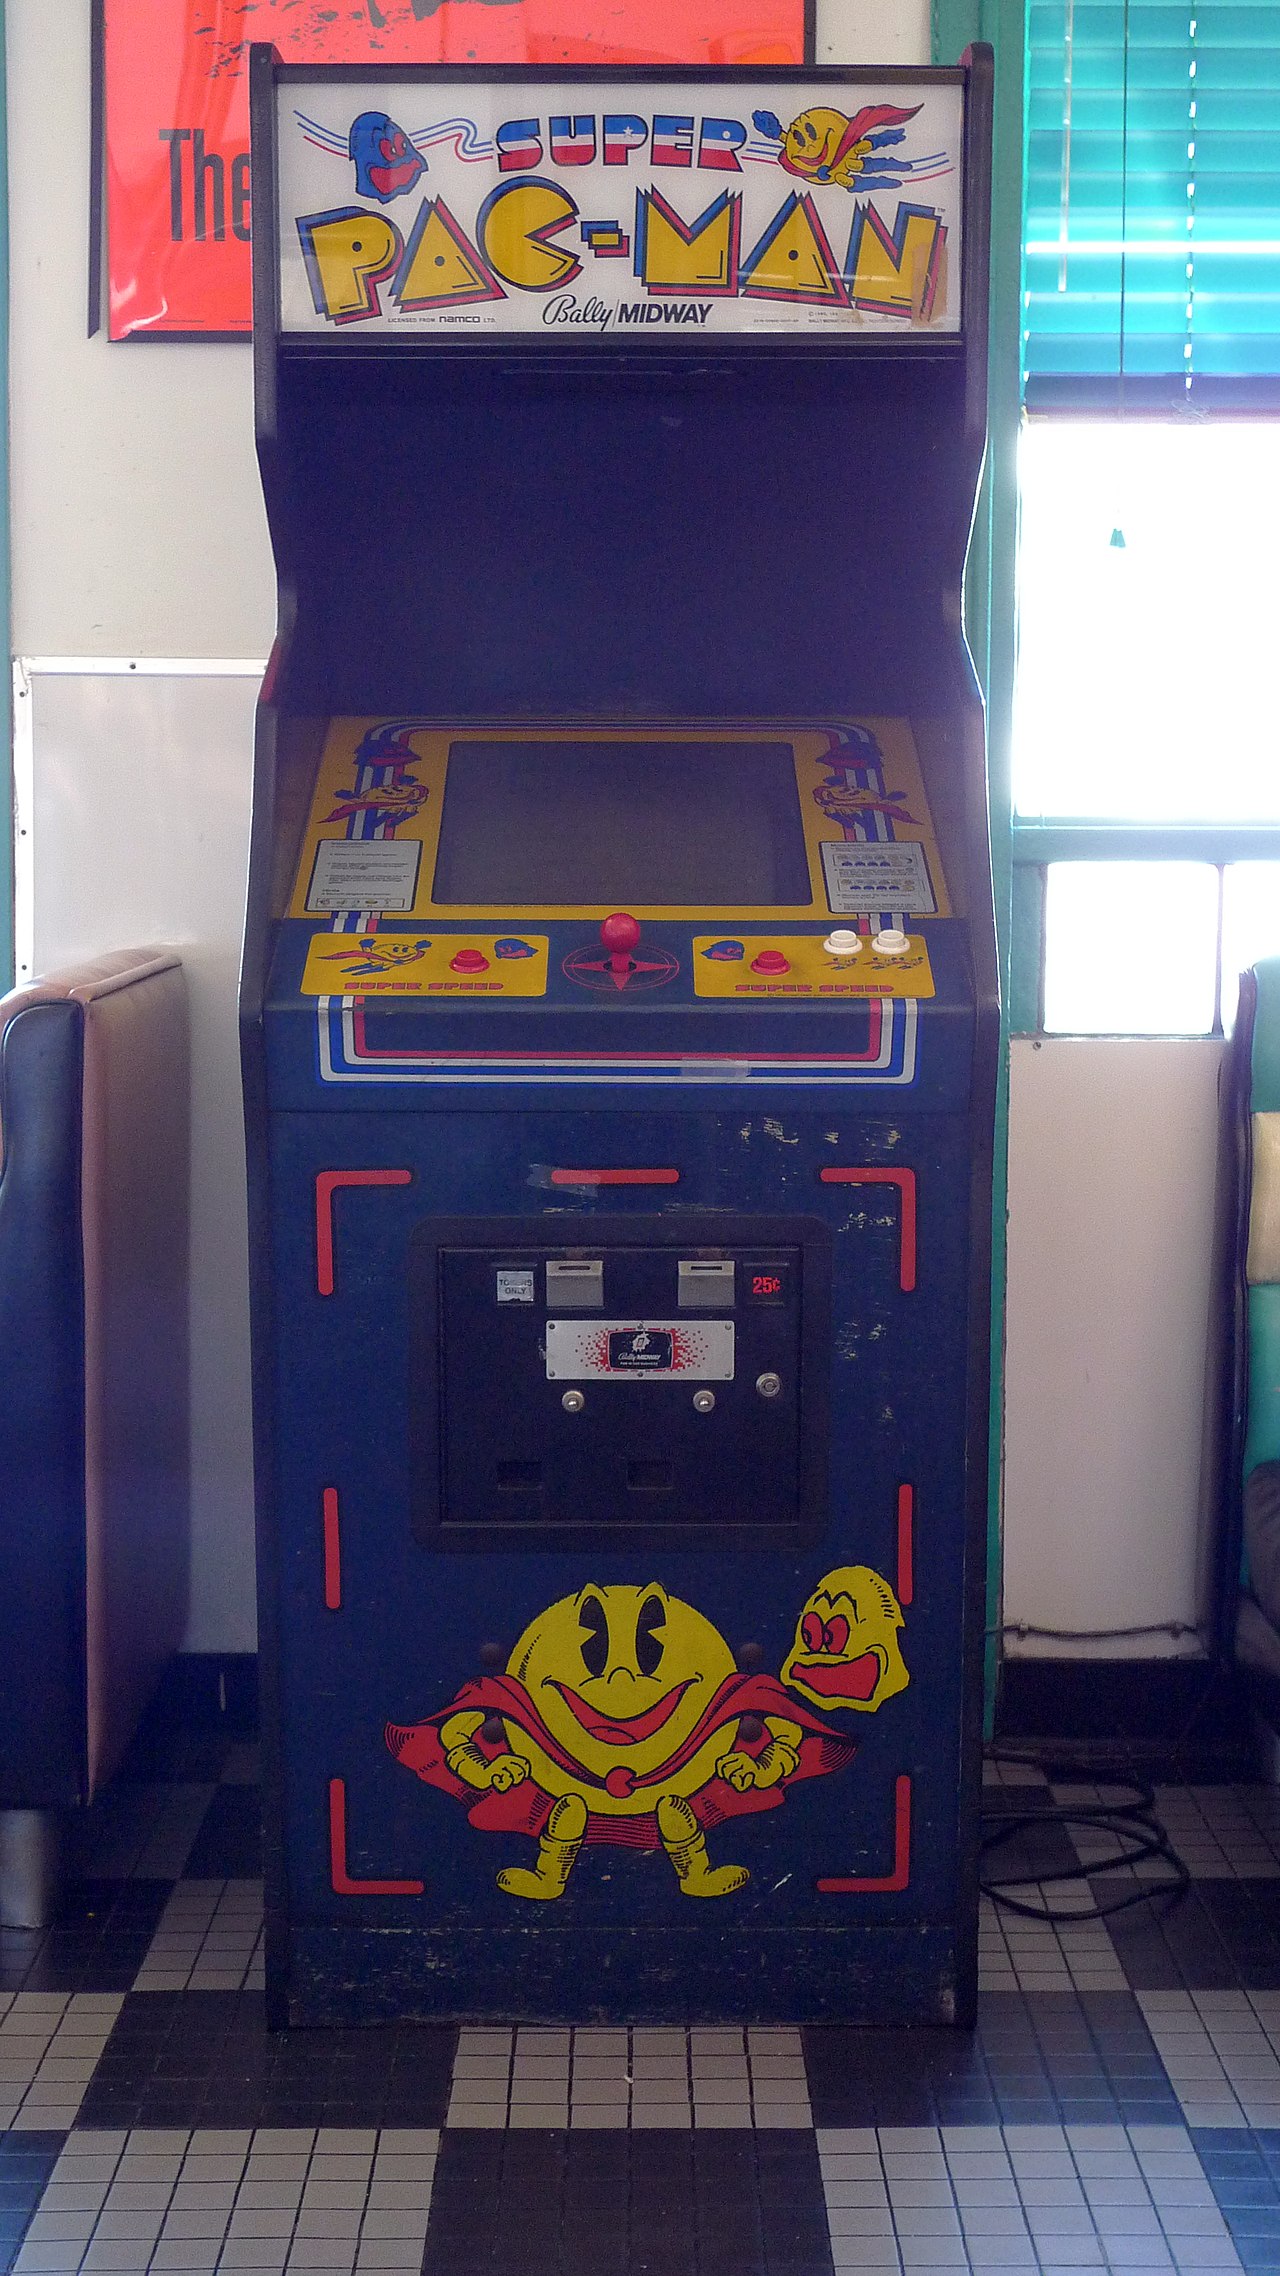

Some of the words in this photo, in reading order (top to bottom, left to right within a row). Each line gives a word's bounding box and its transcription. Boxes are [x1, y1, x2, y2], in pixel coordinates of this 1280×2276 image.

[496, 114, 747, 172] SUPER
[295, 174, 949, 326] PAC-MAN
[387, 316, 418, 324] LICENSED
[438, 314, 481, 324] namco
[542, 293, 614, 331] Bally
[617, 303, 713, 324] MIDWAY
[344, 982, 422, 990] SUPER
[428, 982, 503, 990] SPEED
[735, 984, 812, 992] SUPER
[819, 984, 894, 992] SPEED
[752, 1276, 781, 1294] 25¢
